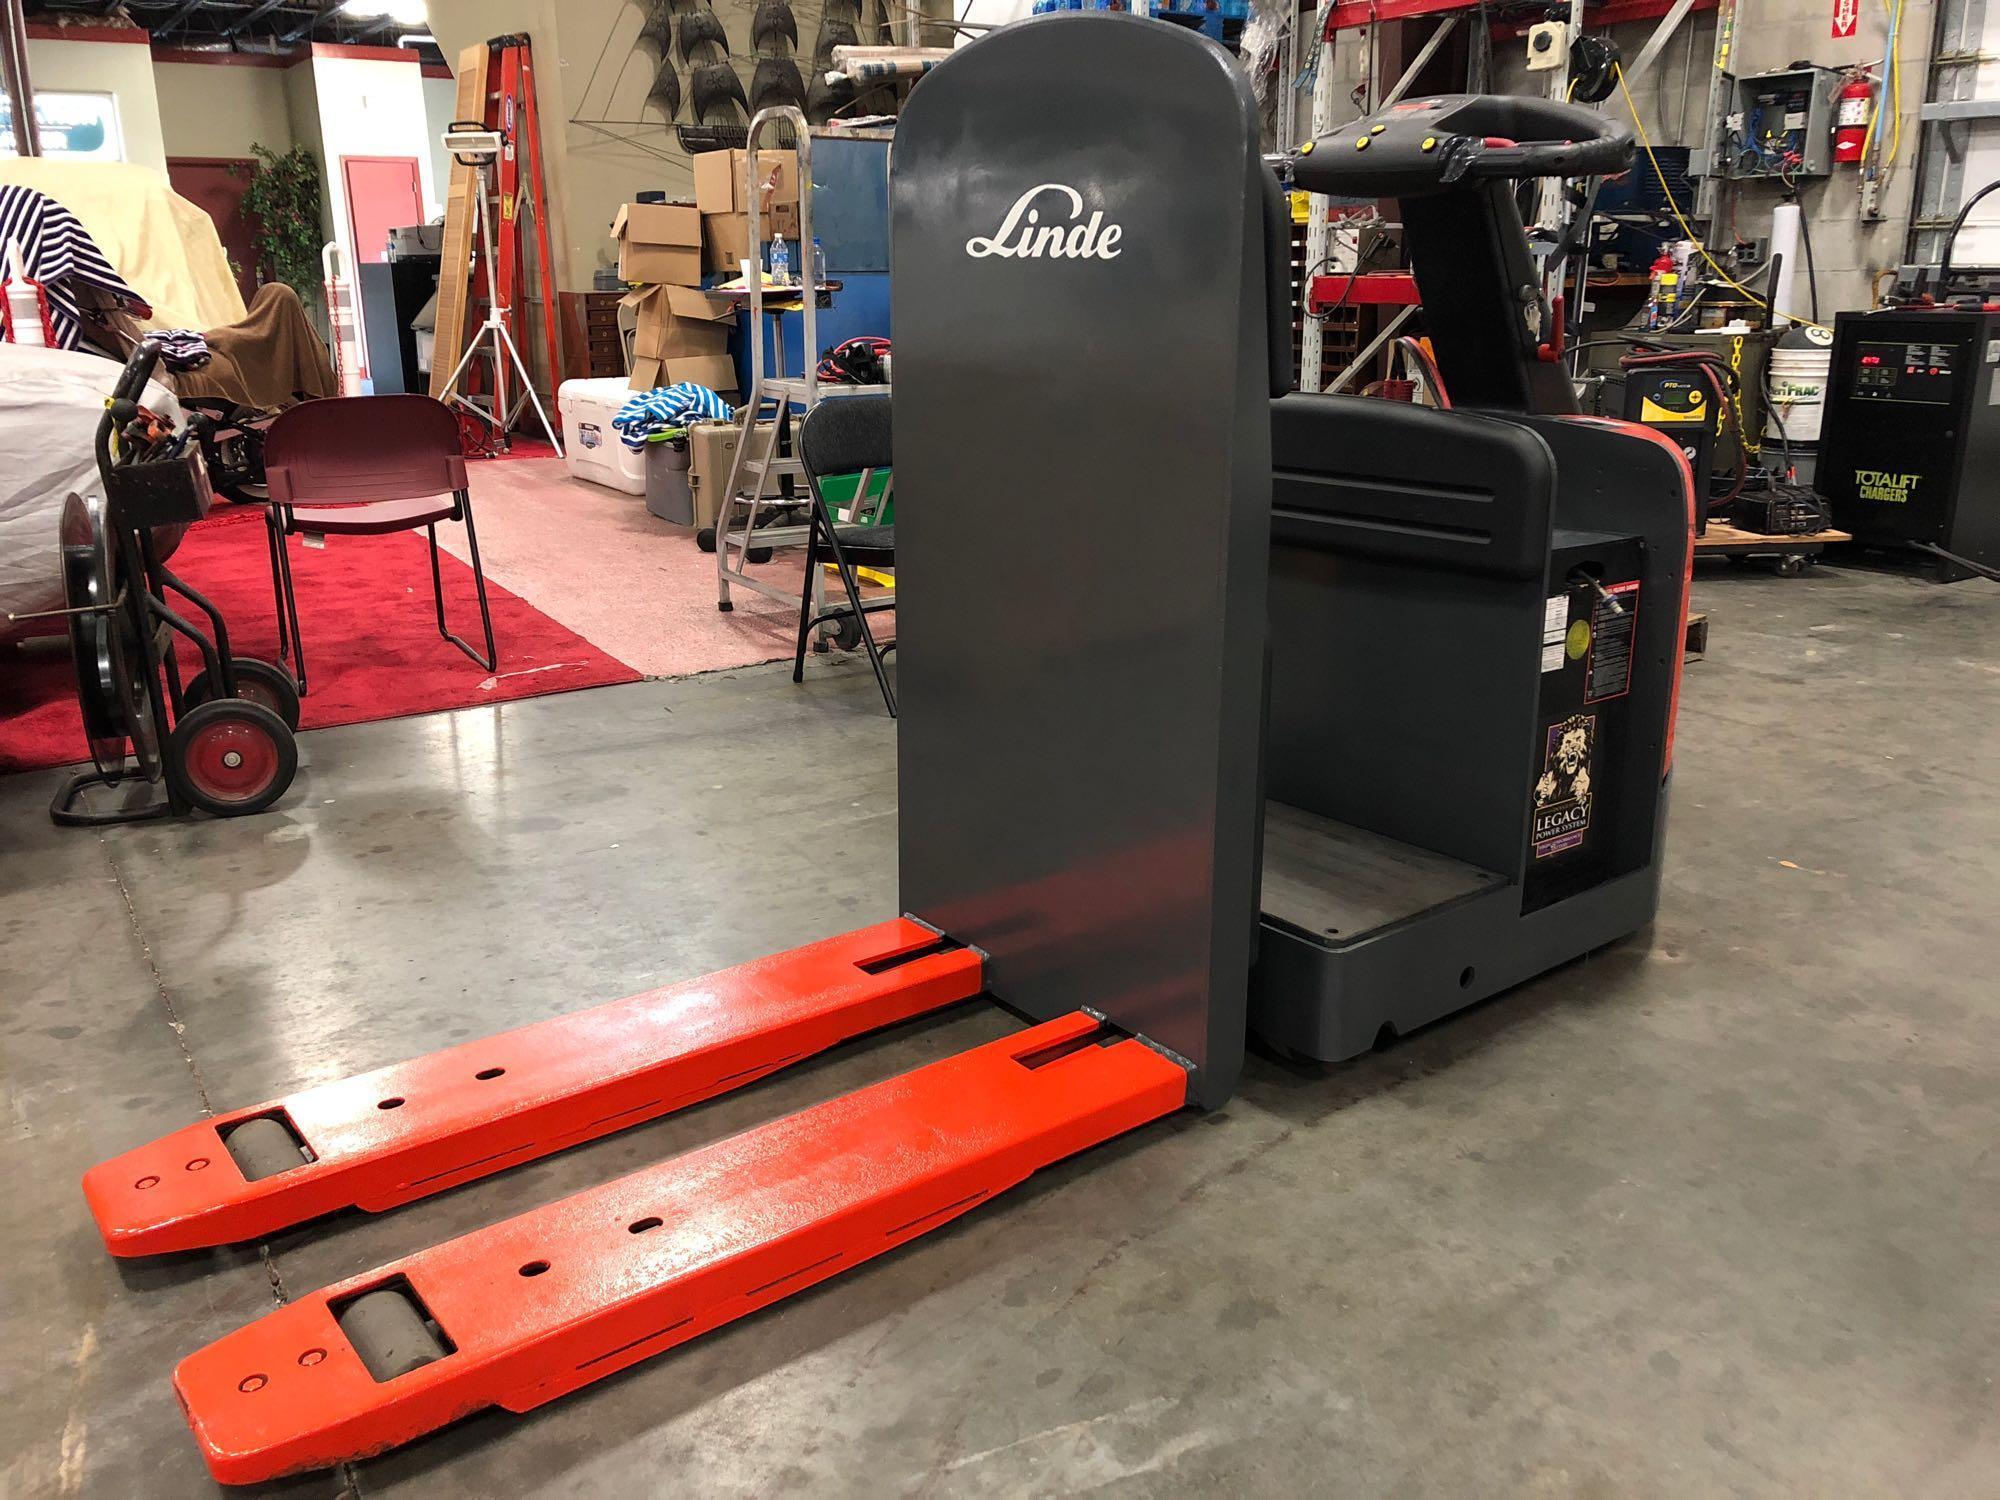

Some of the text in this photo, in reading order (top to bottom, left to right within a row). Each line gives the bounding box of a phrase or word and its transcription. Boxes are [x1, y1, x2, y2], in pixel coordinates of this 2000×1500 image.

[965, 183, 1123, 260] Linde
[1855, 469, 1922, 490] TOTALIFT
[1859, 485, 1908, 503] CHARGERS
[1536, 803, 1590, 832] LEGACY
[1535, 818, 1586, 840] POWER SYSTEM
